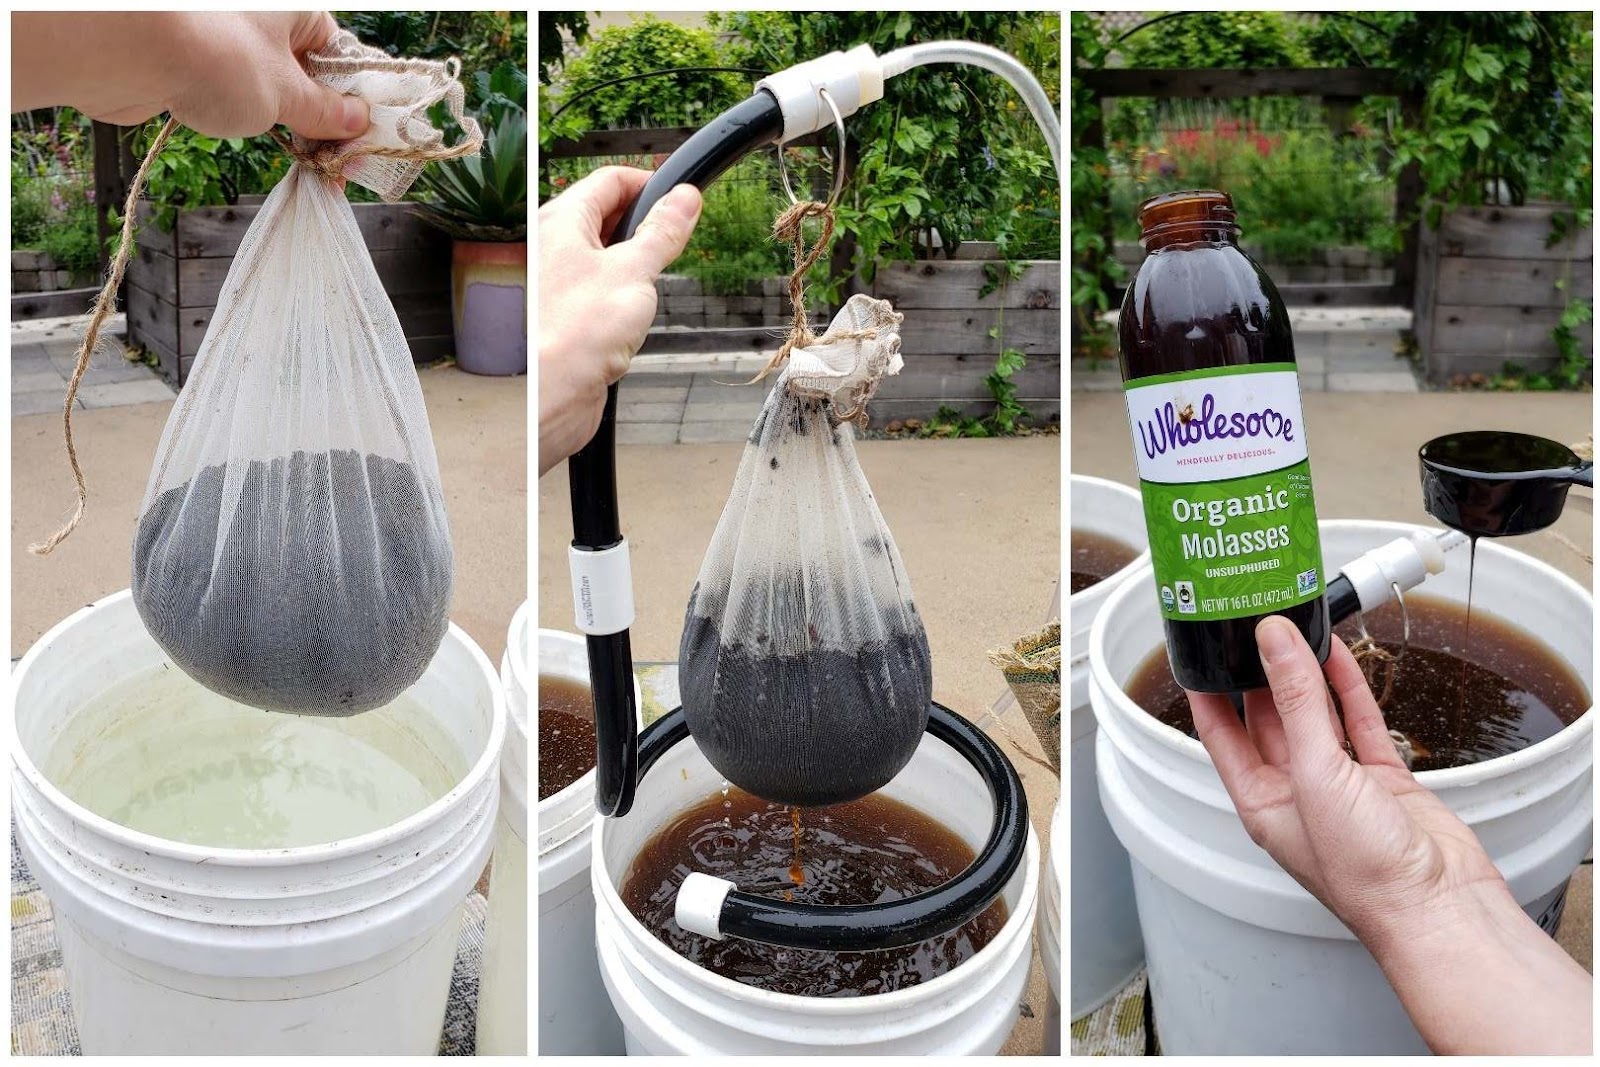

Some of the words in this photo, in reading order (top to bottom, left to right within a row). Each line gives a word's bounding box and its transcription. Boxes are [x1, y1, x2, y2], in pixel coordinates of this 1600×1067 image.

[1138, 393, 1293, 459] Wholesome
[1176, 454, 1224, 466] MINDFULLY
[1172, 485, 1289, 527] Organic
[1181, 523, 1290, 560] Molasses
[1205, 558, 1280, 578] UNSULPHURED
[1201, 599, 1215, 613] NET
[1216, 597, 1229, 611] WT
[1231, 596, 1241, 610] 16
[1241, 595, 1252, 609] FL
[1252, 592, 1264, 607] OZ
[1264, 588, 1281, 606] (472
